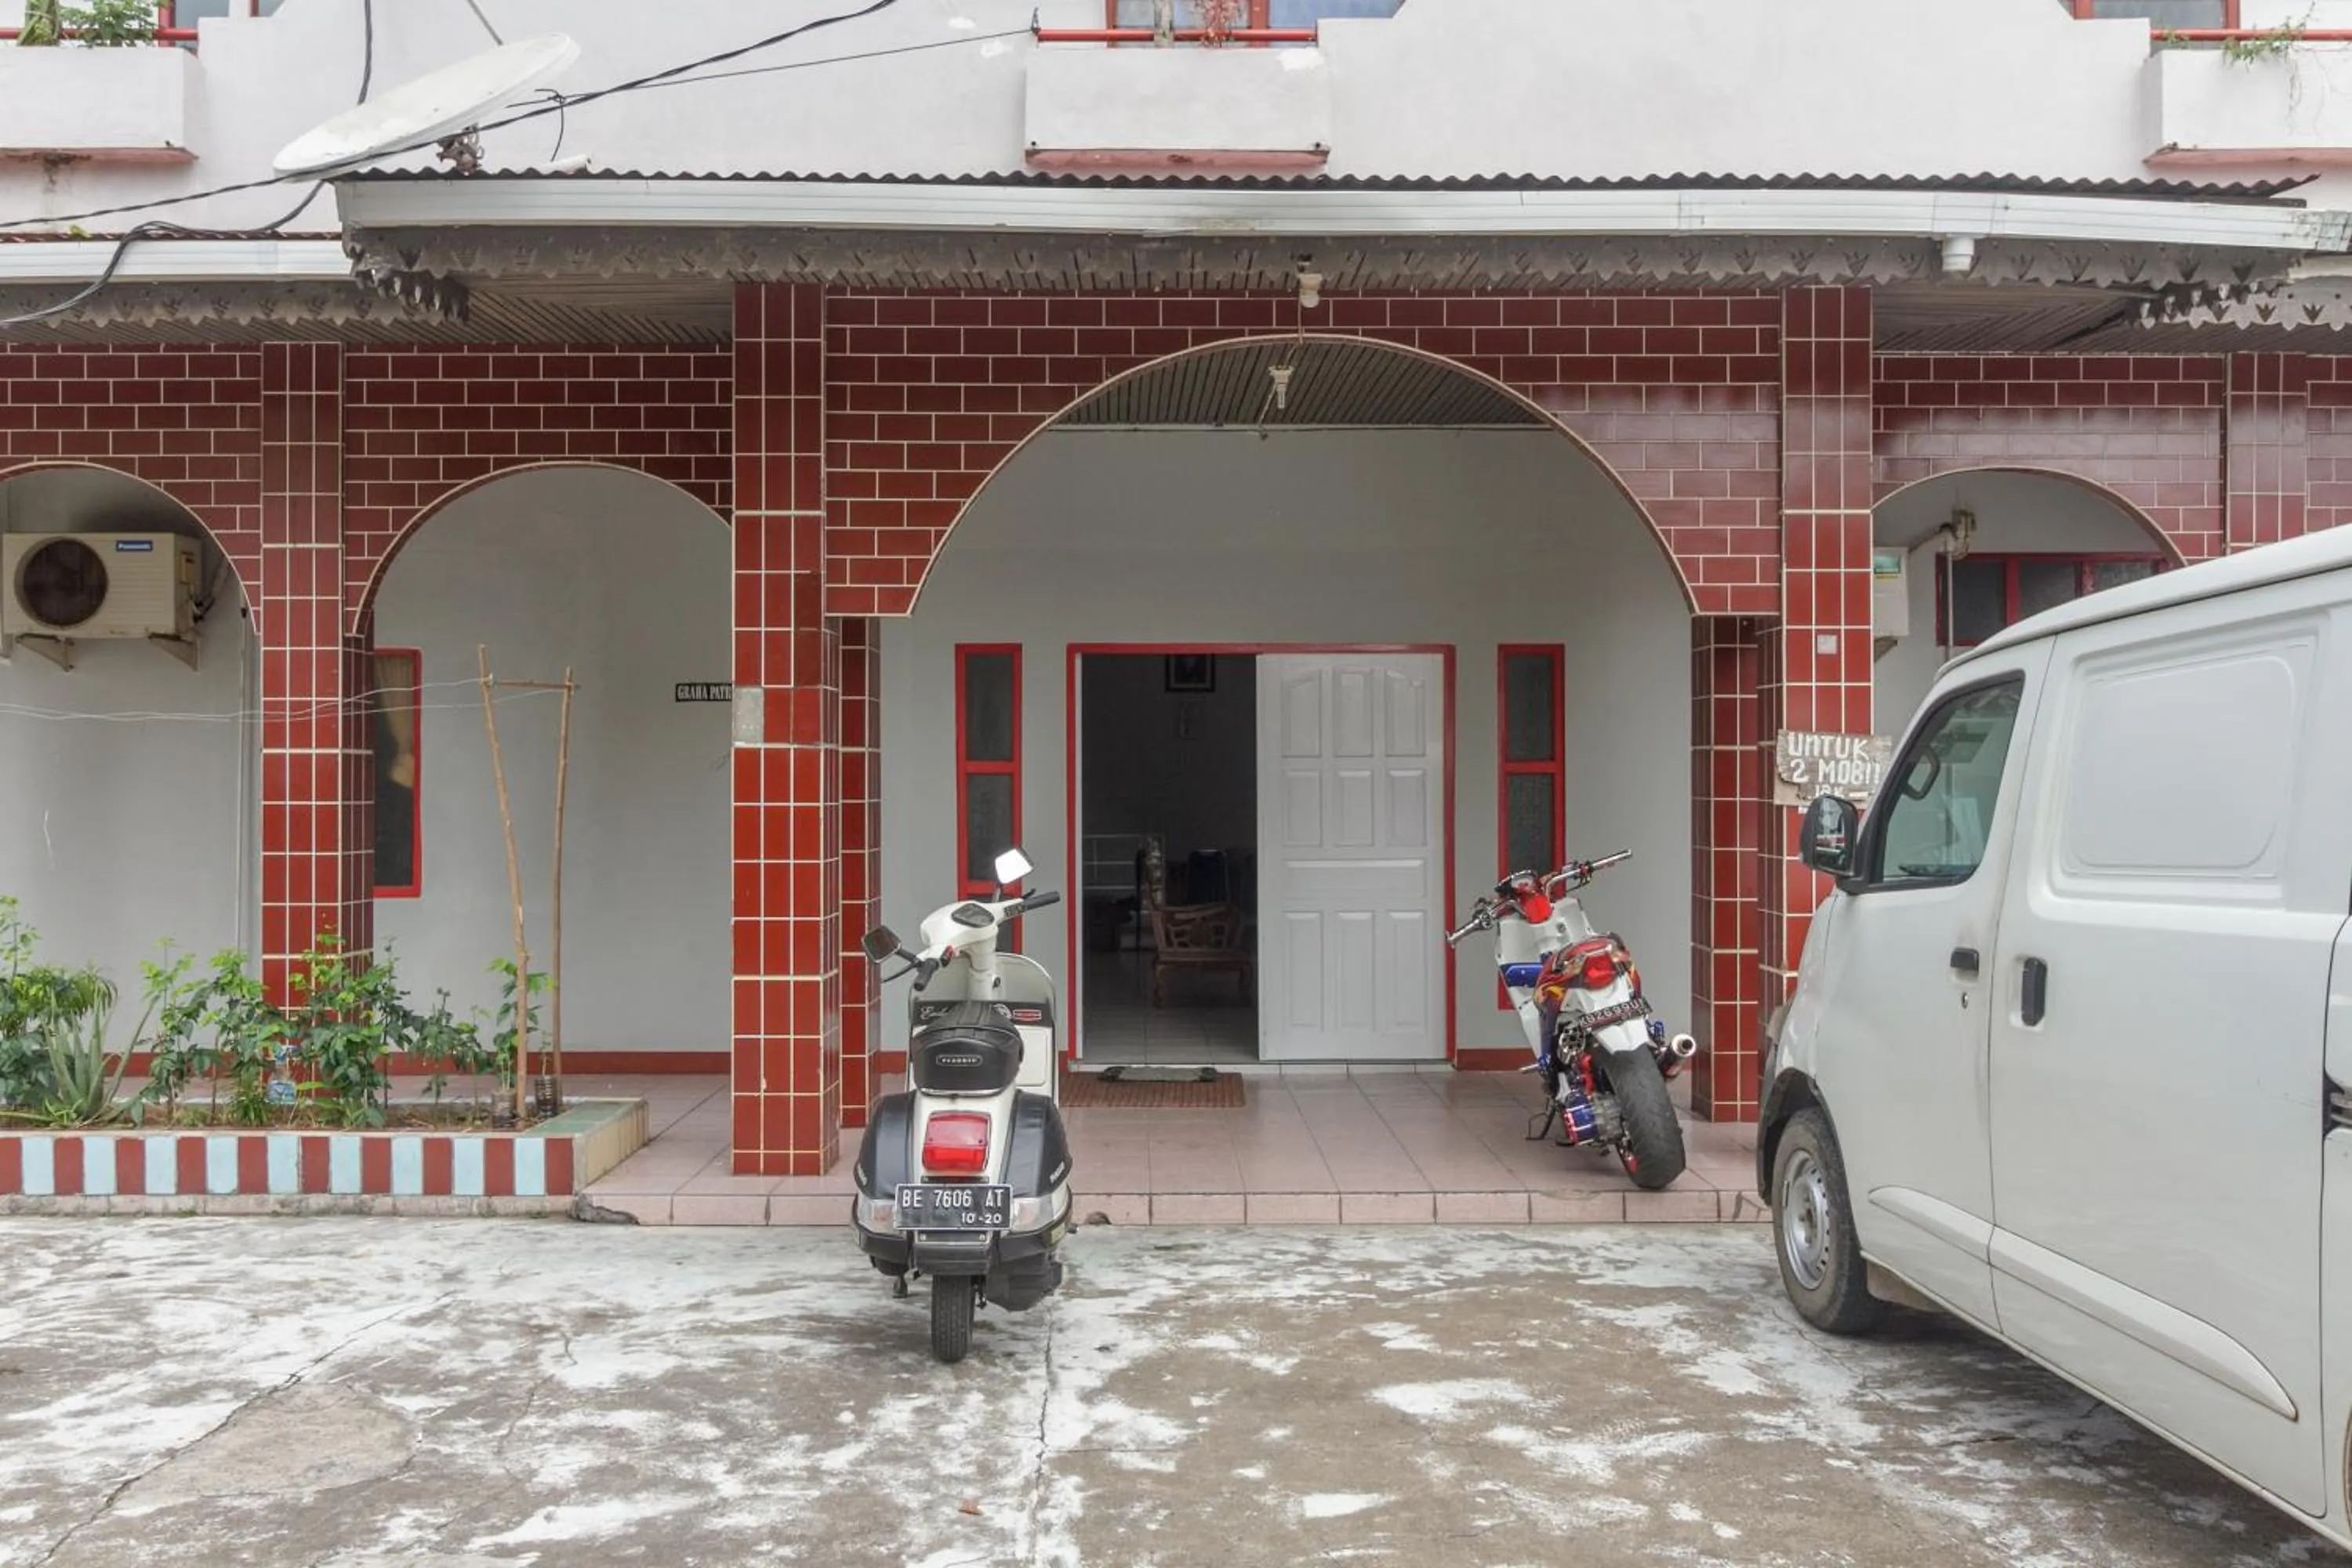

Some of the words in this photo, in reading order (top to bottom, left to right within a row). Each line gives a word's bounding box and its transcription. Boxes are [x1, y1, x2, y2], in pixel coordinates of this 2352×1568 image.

[1788, 731, 1870, 760] UNTUK
[1790, 758, 1809, 783] 2
[902, 1189, 924, 1208] BE
[934, 1189, 972, 1208] 7606
[985, 1189, 1004, 1207] AT
[961, 1213, 1003, 1224] 10-20
